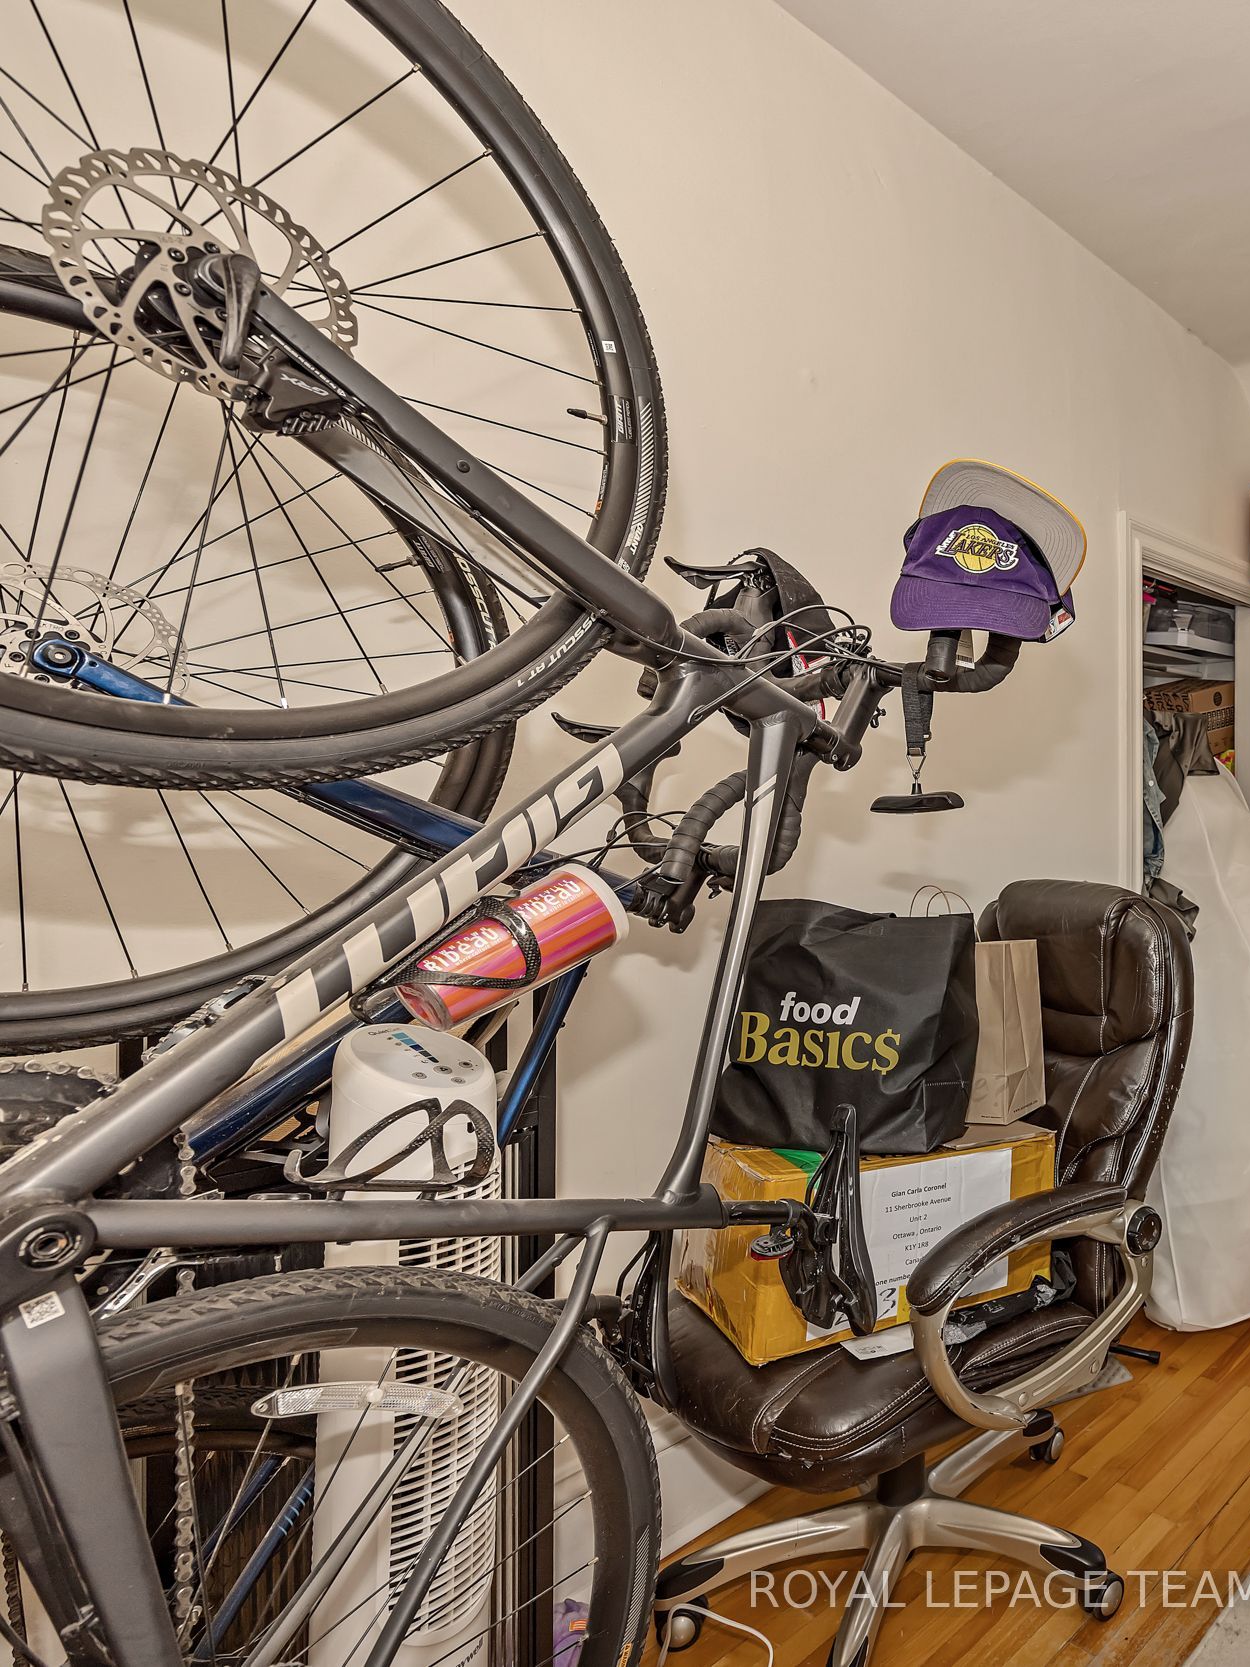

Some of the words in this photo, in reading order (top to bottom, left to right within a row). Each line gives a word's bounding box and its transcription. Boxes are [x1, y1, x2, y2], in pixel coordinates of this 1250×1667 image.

[629, 522, 645, 555] GIANT
[940, 532, 1018, 568] LAKERS
[780, 991, 861, 1025] food
[891, 1190, 905, 1198] Gian
[907, 1187, 922, 1195] Carla
[923, 1183, 947, 1193] Coronel
[894, 1200, 929, 1212] Sherbrooke
[930, 1196, 952, 1205] Avenue
[909, 1215, 922, 1223] Unit
[919, 1225, 942, 1234] Ontario
[904, 1243, 917, 1251] K1Y
[889, 1274, 911, 1283] numbe
